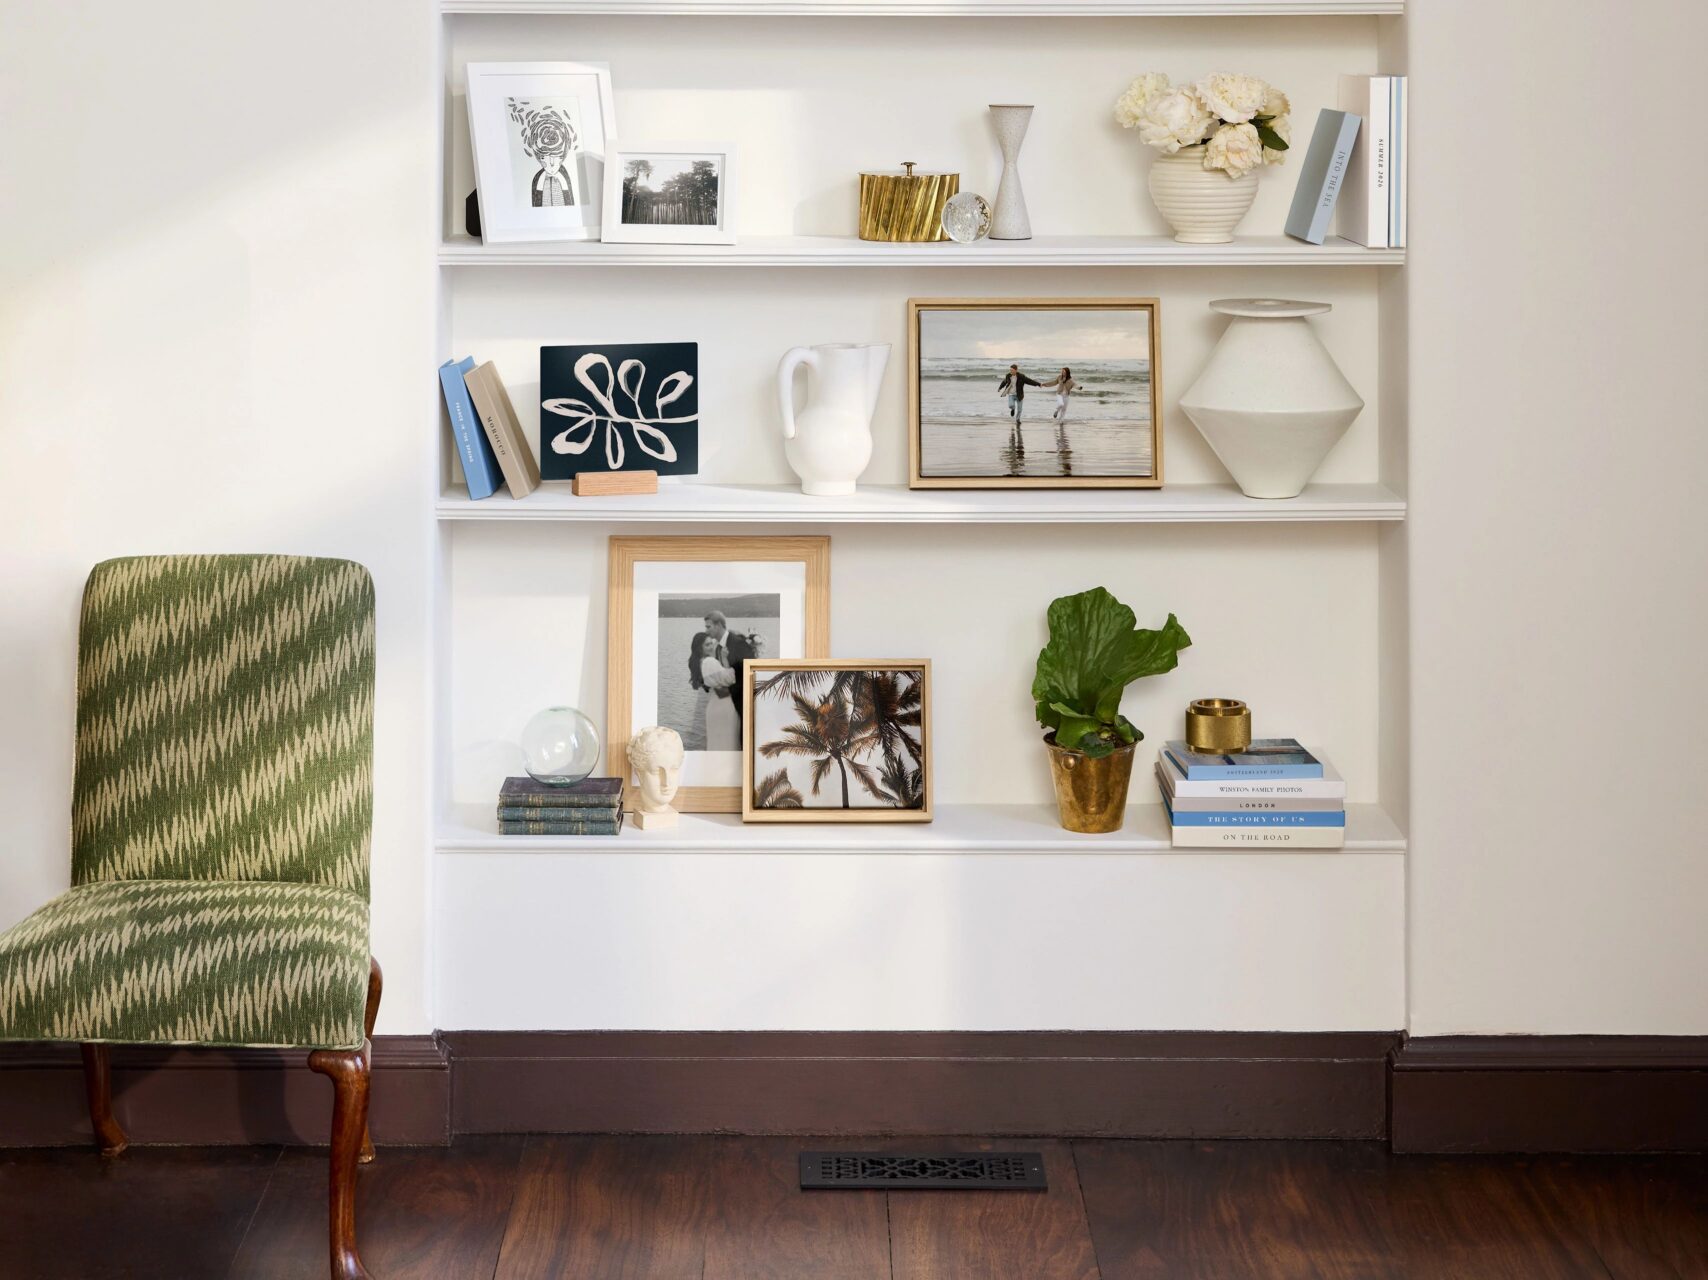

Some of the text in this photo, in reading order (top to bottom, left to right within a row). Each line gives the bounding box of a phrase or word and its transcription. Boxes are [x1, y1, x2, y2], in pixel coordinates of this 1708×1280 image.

[1322, 151, 1346, 207] INTO THE SEA
[487, 416, 506, 455] MOROCCO
